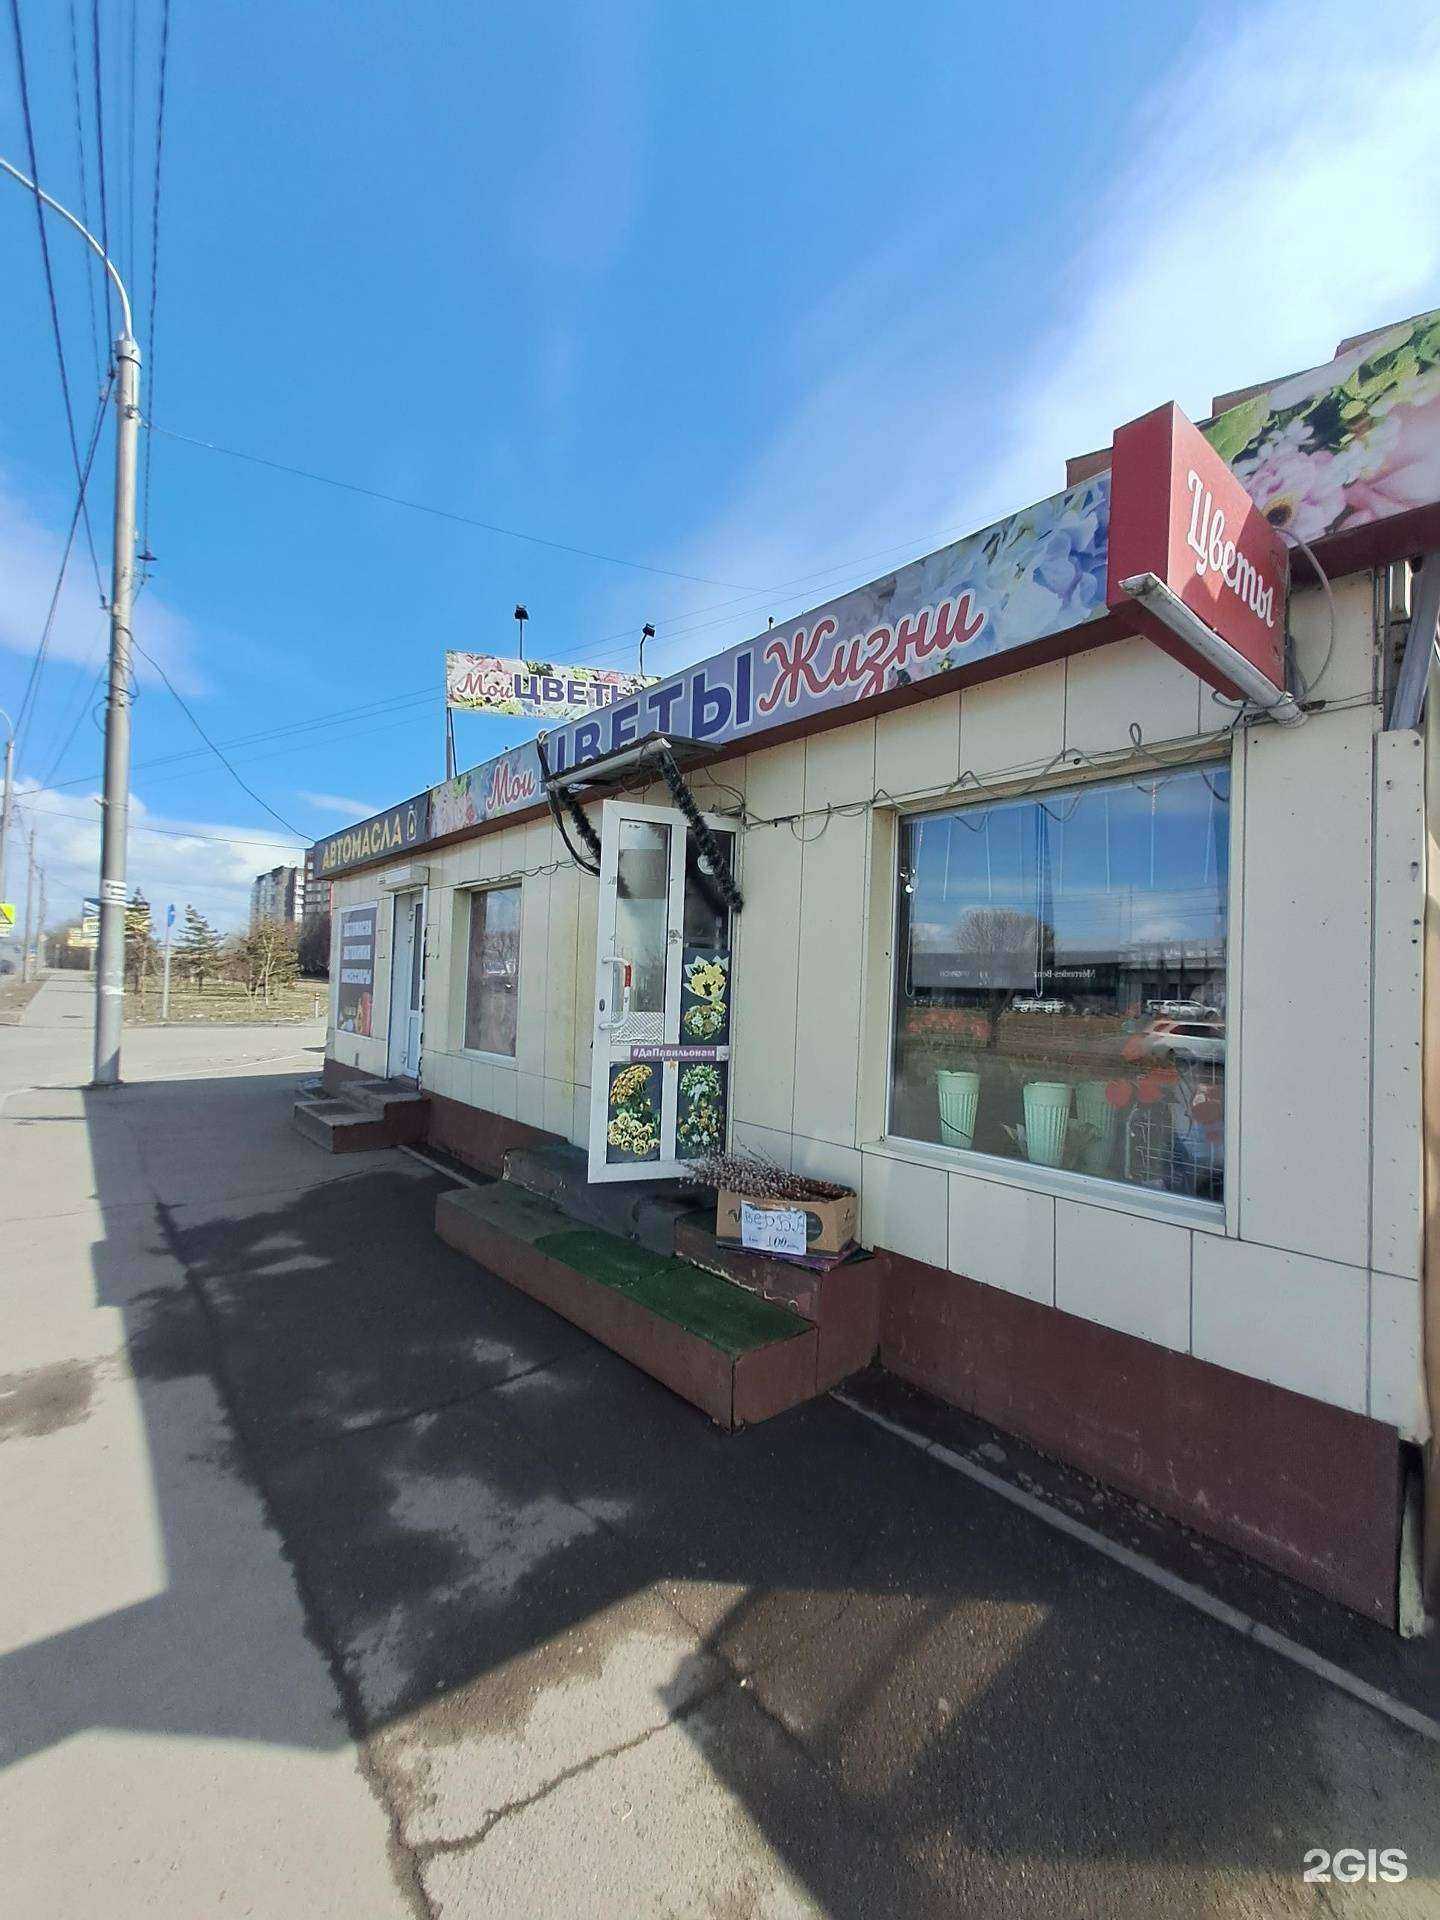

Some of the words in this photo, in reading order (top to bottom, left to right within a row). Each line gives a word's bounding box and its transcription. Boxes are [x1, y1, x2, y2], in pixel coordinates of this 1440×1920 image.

[1187, 469, 1275, 628] Цветы
[457, 673, 513, 699] Мои
[486, 763, 536, 810] Мои
[758, 594, 984, 712] Жизни
[322, 813, 402, 870] АВТОМАСЛА
[632, 1047, 715, 1059] #ДаПавильонам
